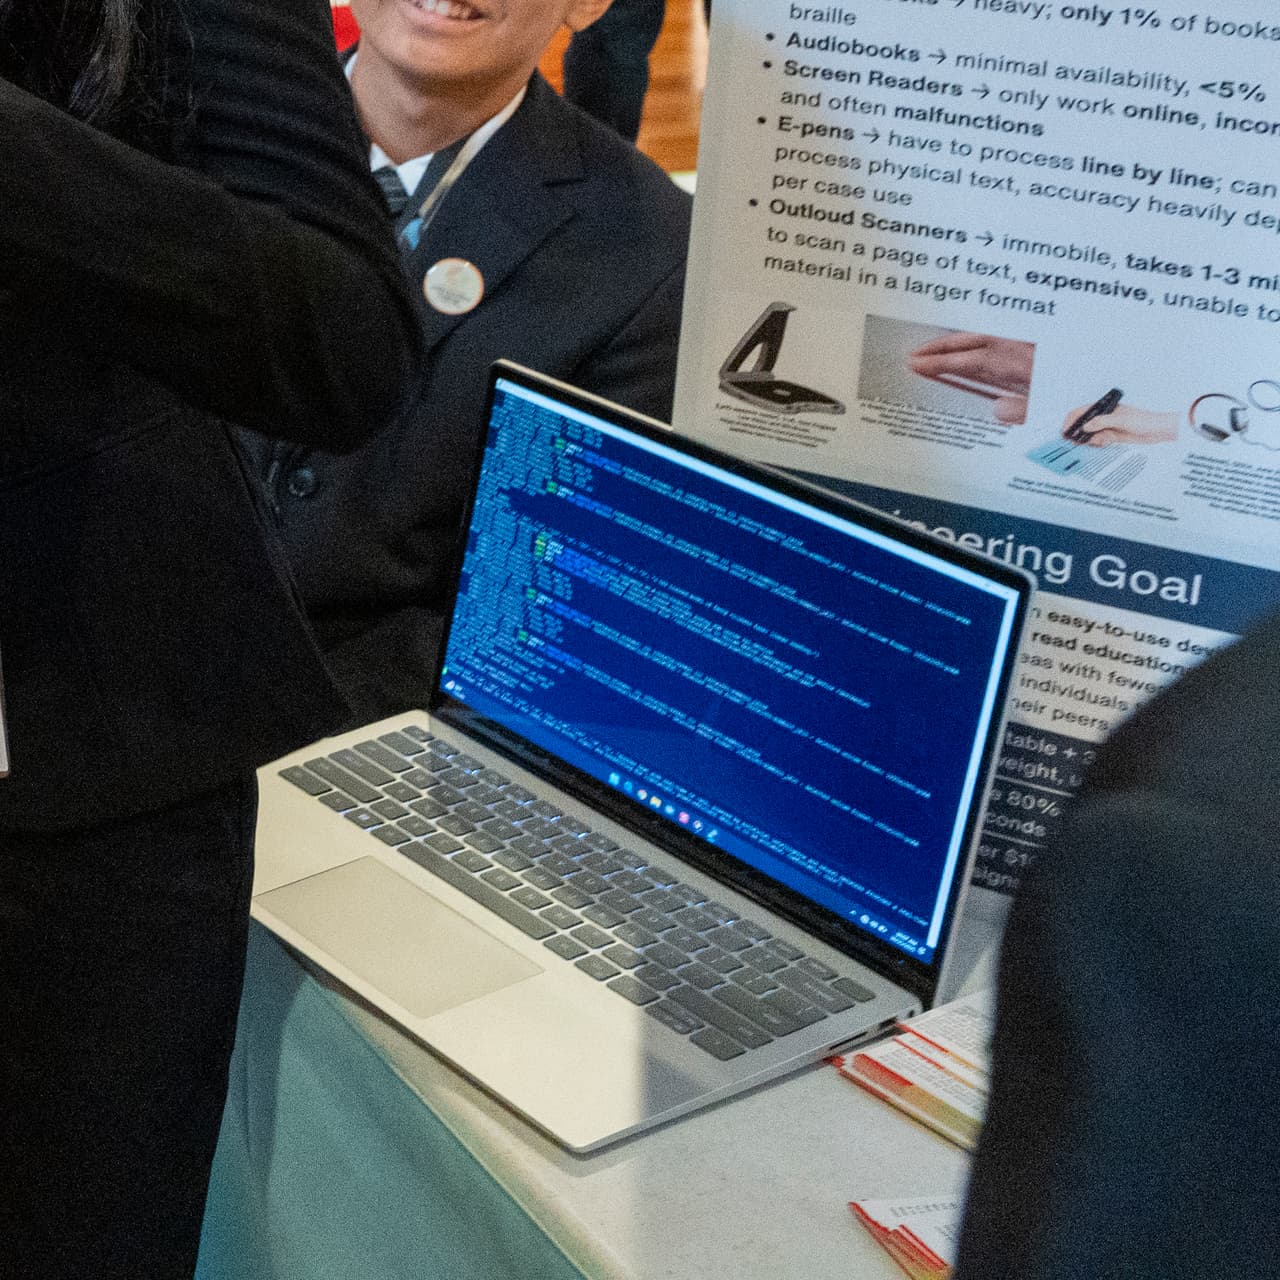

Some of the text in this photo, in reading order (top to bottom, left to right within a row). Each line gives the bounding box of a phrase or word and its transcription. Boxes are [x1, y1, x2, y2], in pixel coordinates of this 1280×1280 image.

[790, 4, 857, 26] braille
[1060, 5, 1113, 27] only
[1122, 8, 1161, 29] 1%
[786, 32, 1266, 103] Audiobooks minimal availability, <5%
[780, 91, 1044, 137] and often malfunctions
[784, 60, 1205, 130] Screen Readers only work online,
[778, 116, 1277, 198] E-pens have process line by line; can
[772, 175, 913, 207] per case use
[775, 147, 1237, 227] process physical text, accuracy heavily
[769, 199, 1240, 286] Outloud Scanners immobile, takes 1-3
[764, 256, 1056, 316] material larger format
[795, 233, 1249, 318] scan page text, expensive, unable
[1090, 554, 1203, 607] Goal
[1030, 629, 1078, 652] read
[1046, 609, 1171, 650] easy-to-use
[1020, 673, 1132, 713] individuals
[1058, 659, 1103, 682] with
